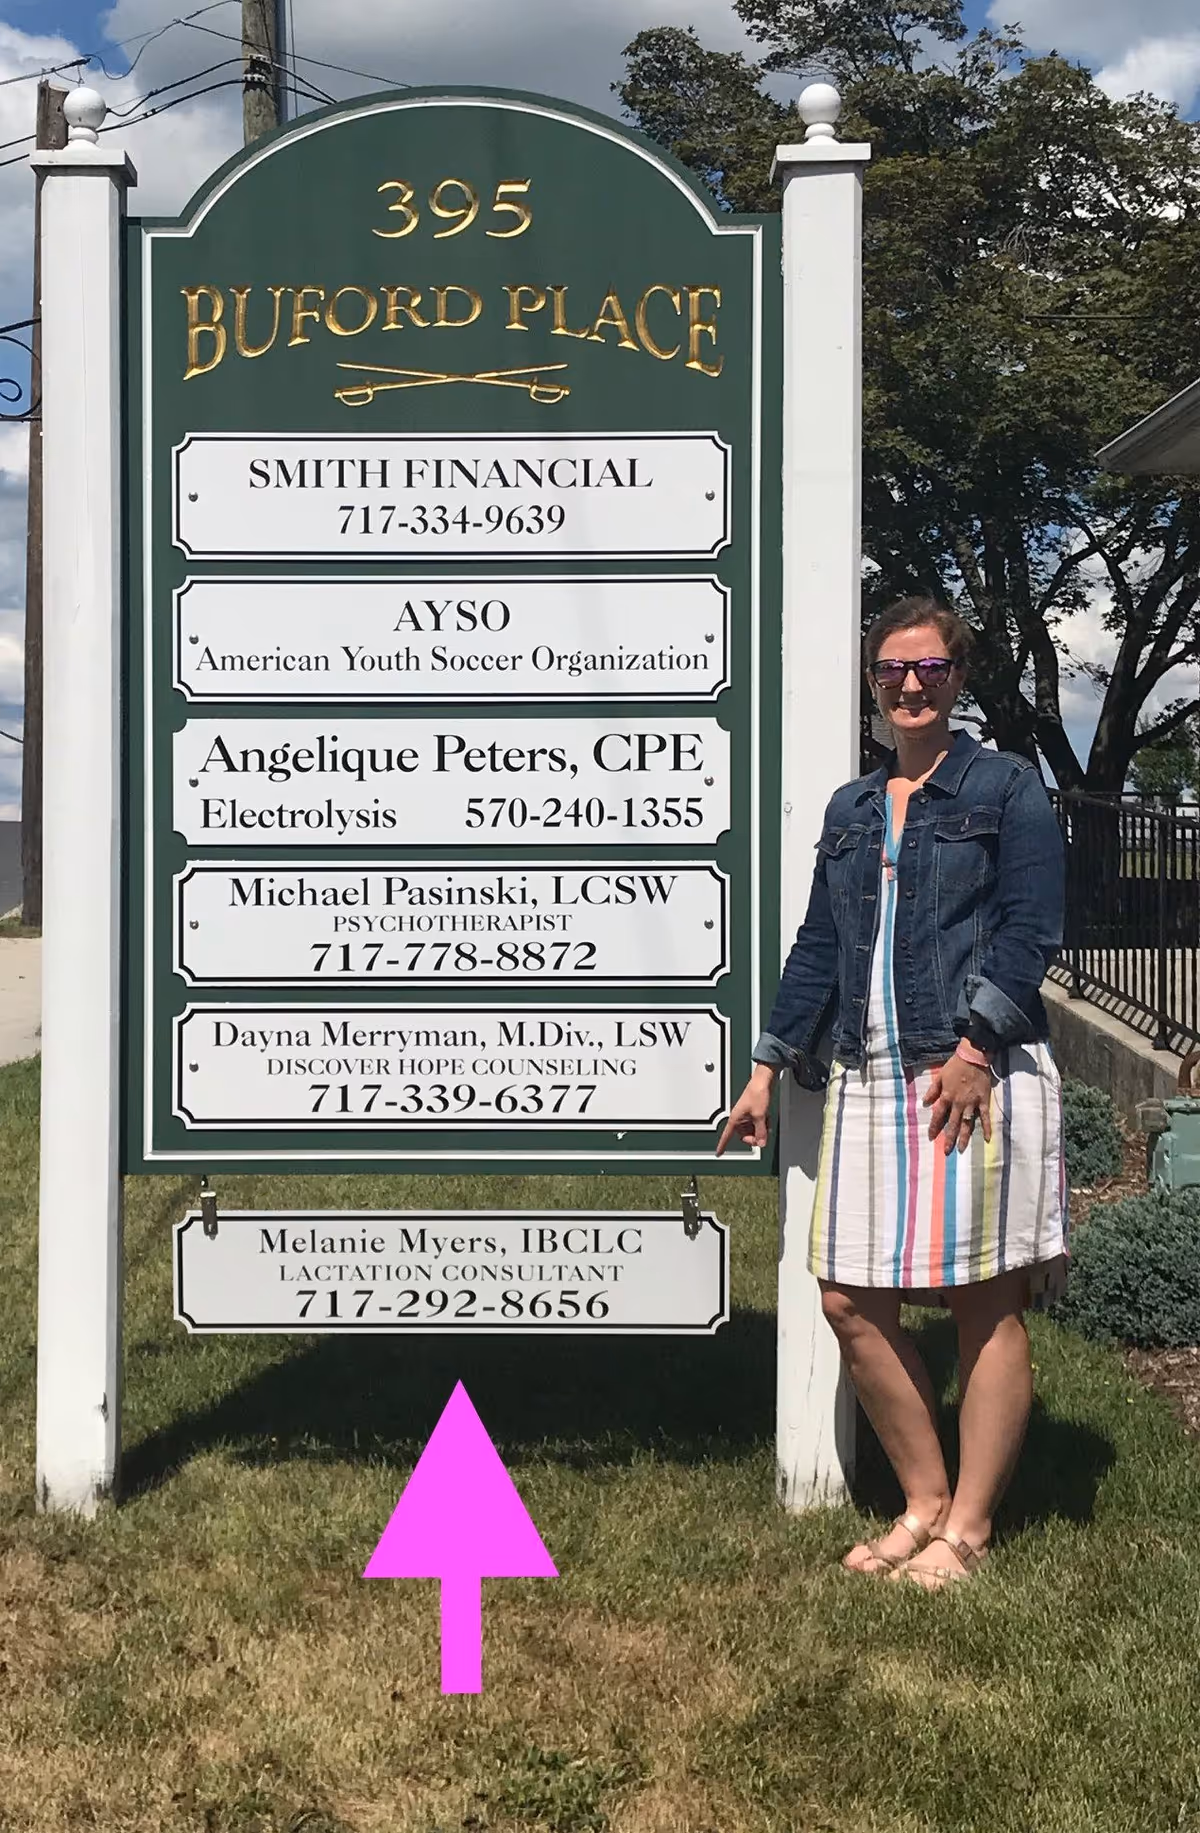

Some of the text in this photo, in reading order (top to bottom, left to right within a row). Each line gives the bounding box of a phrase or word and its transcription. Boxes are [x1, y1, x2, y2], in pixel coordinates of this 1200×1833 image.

[372, 176, 533, 240] 395
[181, 283, 724, 381] BUFORD PLACE
[249, 458, 654, 489] SMITH FINANCIAL
[338, 504, 566, 535] 717-334-9639
[393, 599, 511, 632] AYSO
[195, 645, 710, 677] American Youth Soccer Organization
[199, 733, 704, 782] Angelique Peters, CPE
[200, 798, 397, 836] Electrolysis
[465, 796, 704, 829] 570-240-1355
[229, 875, 678, 910] Michael Pasinski, LCSW
[334, 914, 573, 933] PSYCHOTHERAPIST
[310, 941, 597, 972] 717-778-8872
[213, 1021, 692, 1053] Dayna Merryman, M.Div., LSW
[268, 1058, 636, 1076] DISCOVER HOPE COUNSELING
[308, 1083, 597, 1114] 717-339-6377
[259, 1228, 642, 1260] Melanie Myers, IBCLC
[280, 1264, 624, 1282] LACTATION CONSULTANT
[296, 1289, 610, 1319] 717-292-8656
